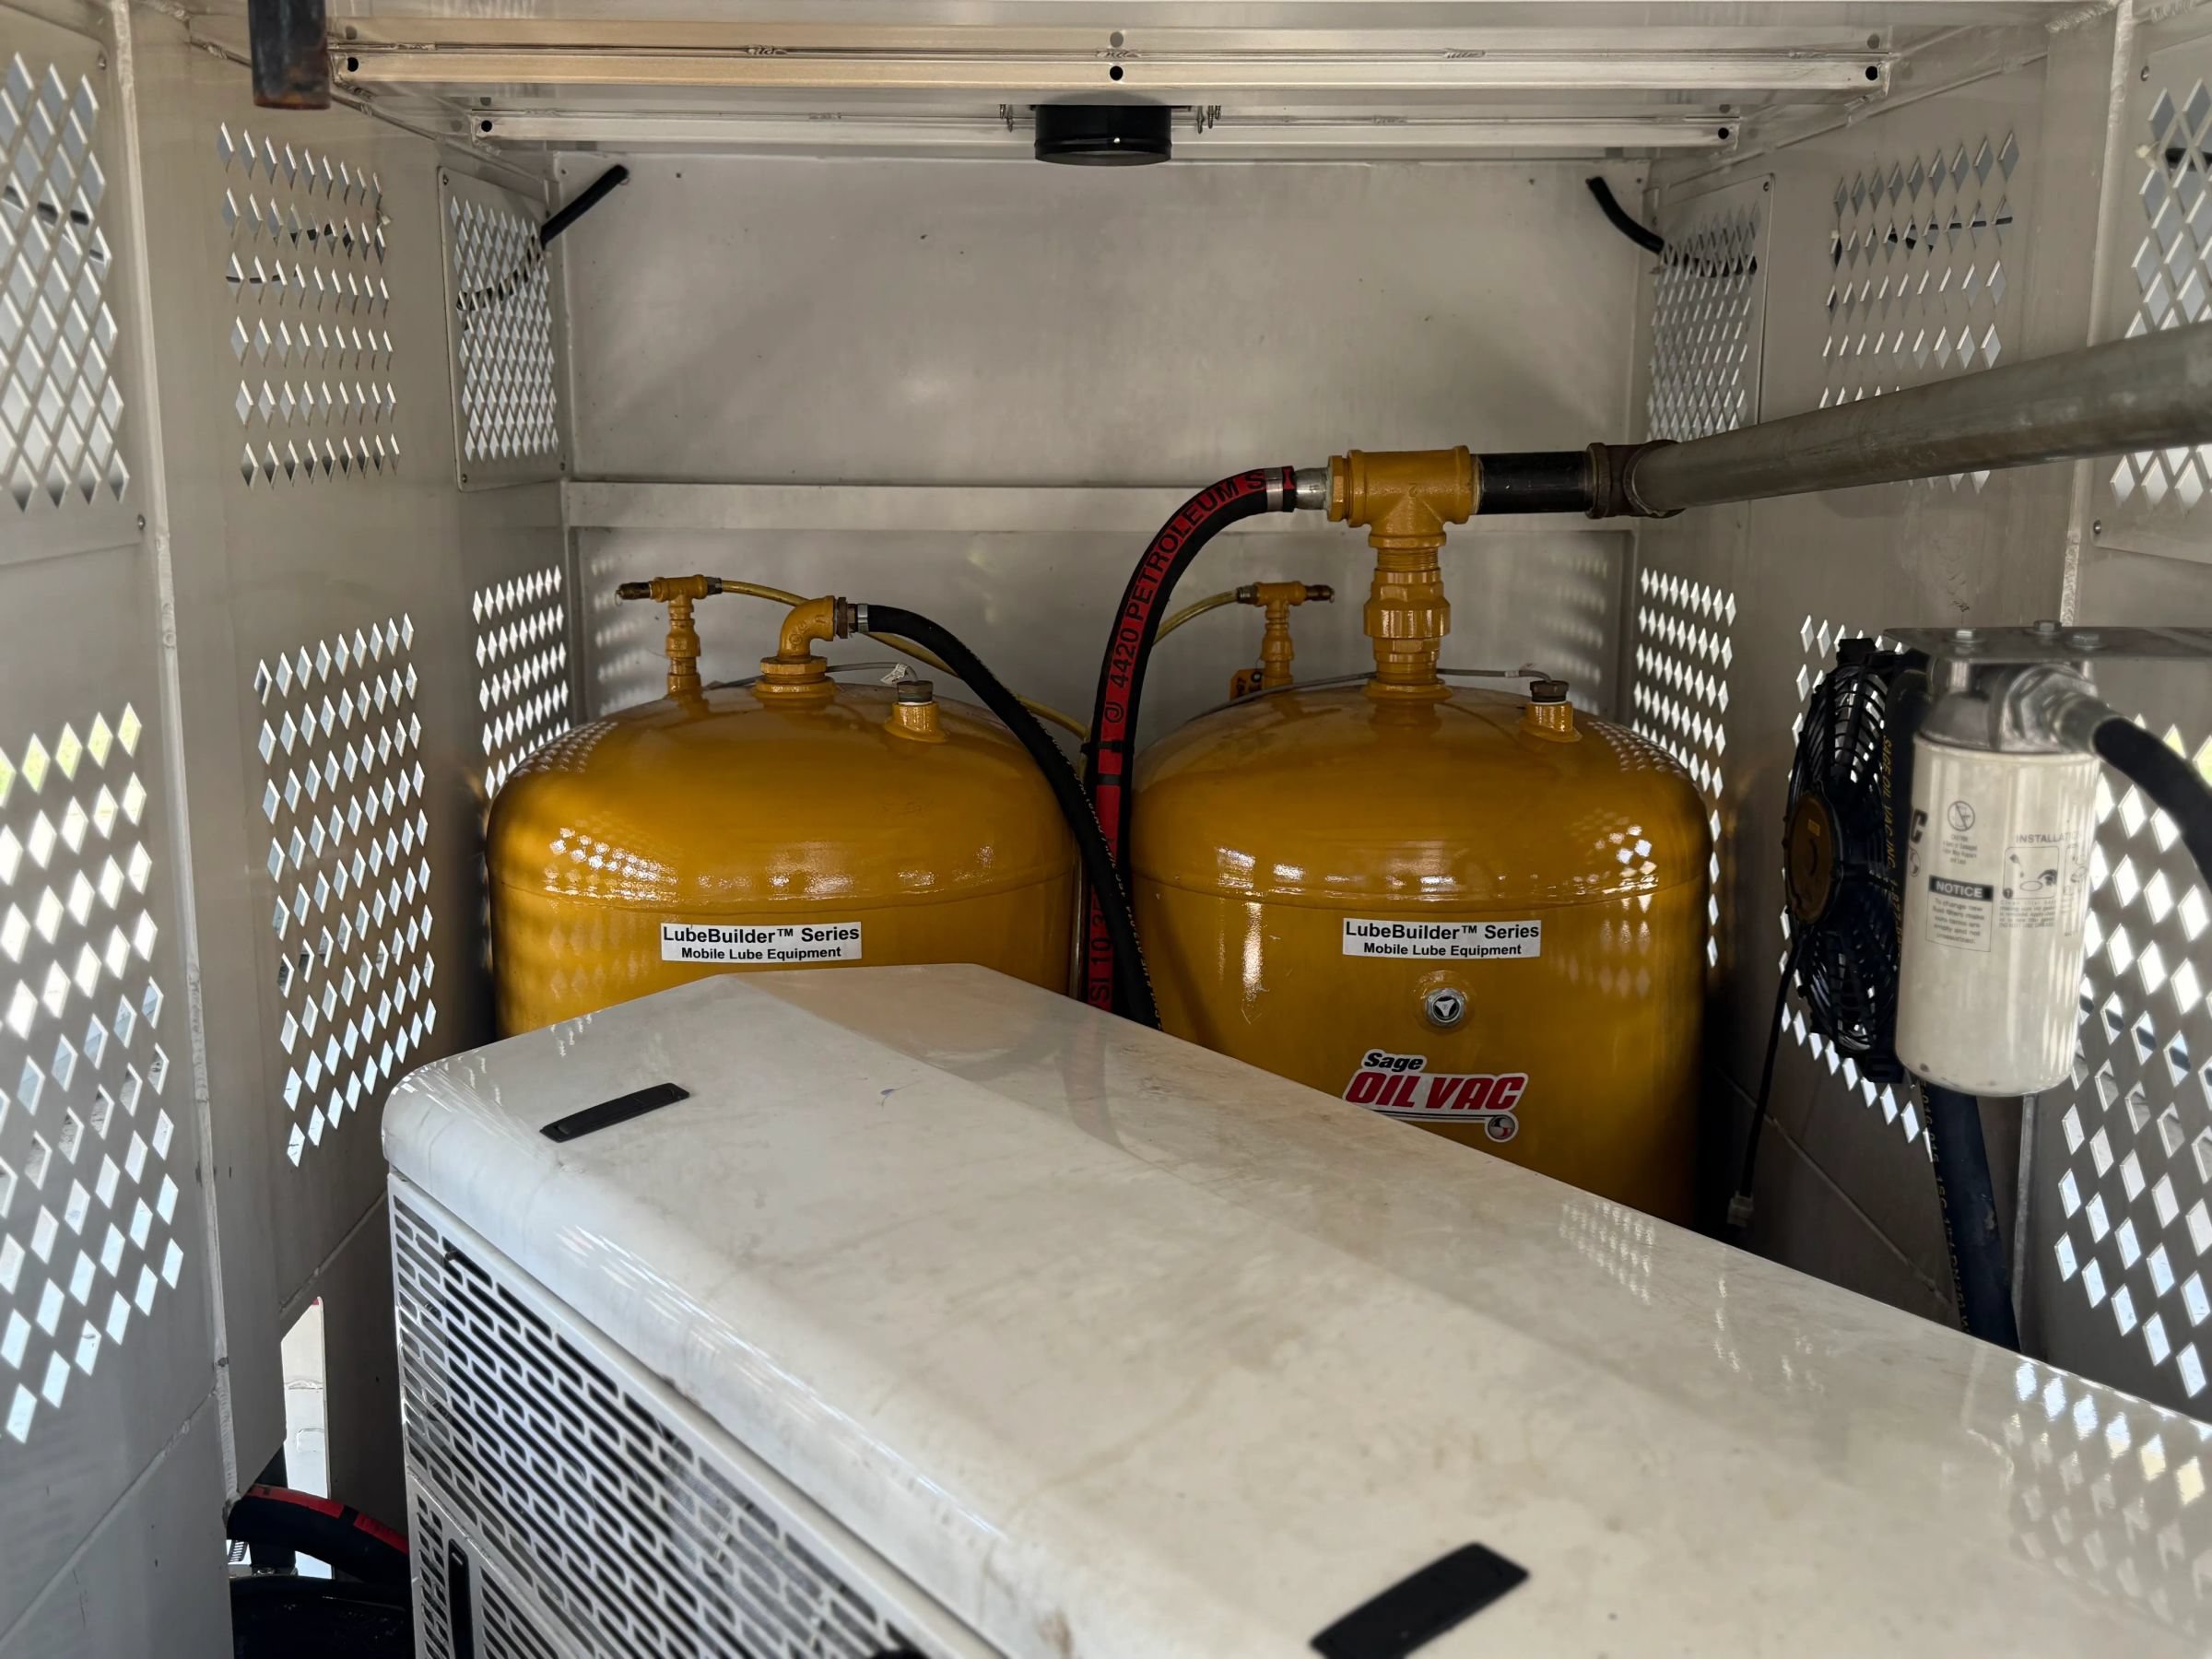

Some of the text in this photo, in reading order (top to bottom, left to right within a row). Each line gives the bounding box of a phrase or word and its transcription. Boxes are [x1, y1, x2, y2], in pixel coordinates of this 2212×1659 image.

[1124, 478, 1240, 621] PETROLEUM
[1110, 628, 1140, 689] 4420
[1882, 776, 1892, 798] OIL
[1883, 804, 1894, 837] VAC
[1936, 881, 1983, 898] NOTICE
[801, 924, 860, 942] Series
[1484, 923, 1540, 939] Series
[681, 946, 841, 961] Mobile Lube Equipment
[1363, 942, 1522, 959] Mobile Lube Equipment
[1089, 977, 1112, 1009] SI
[1364, 1052, 1424, 1073] Sage
[1346, 1072, 1525, 1111] OIL VAC
